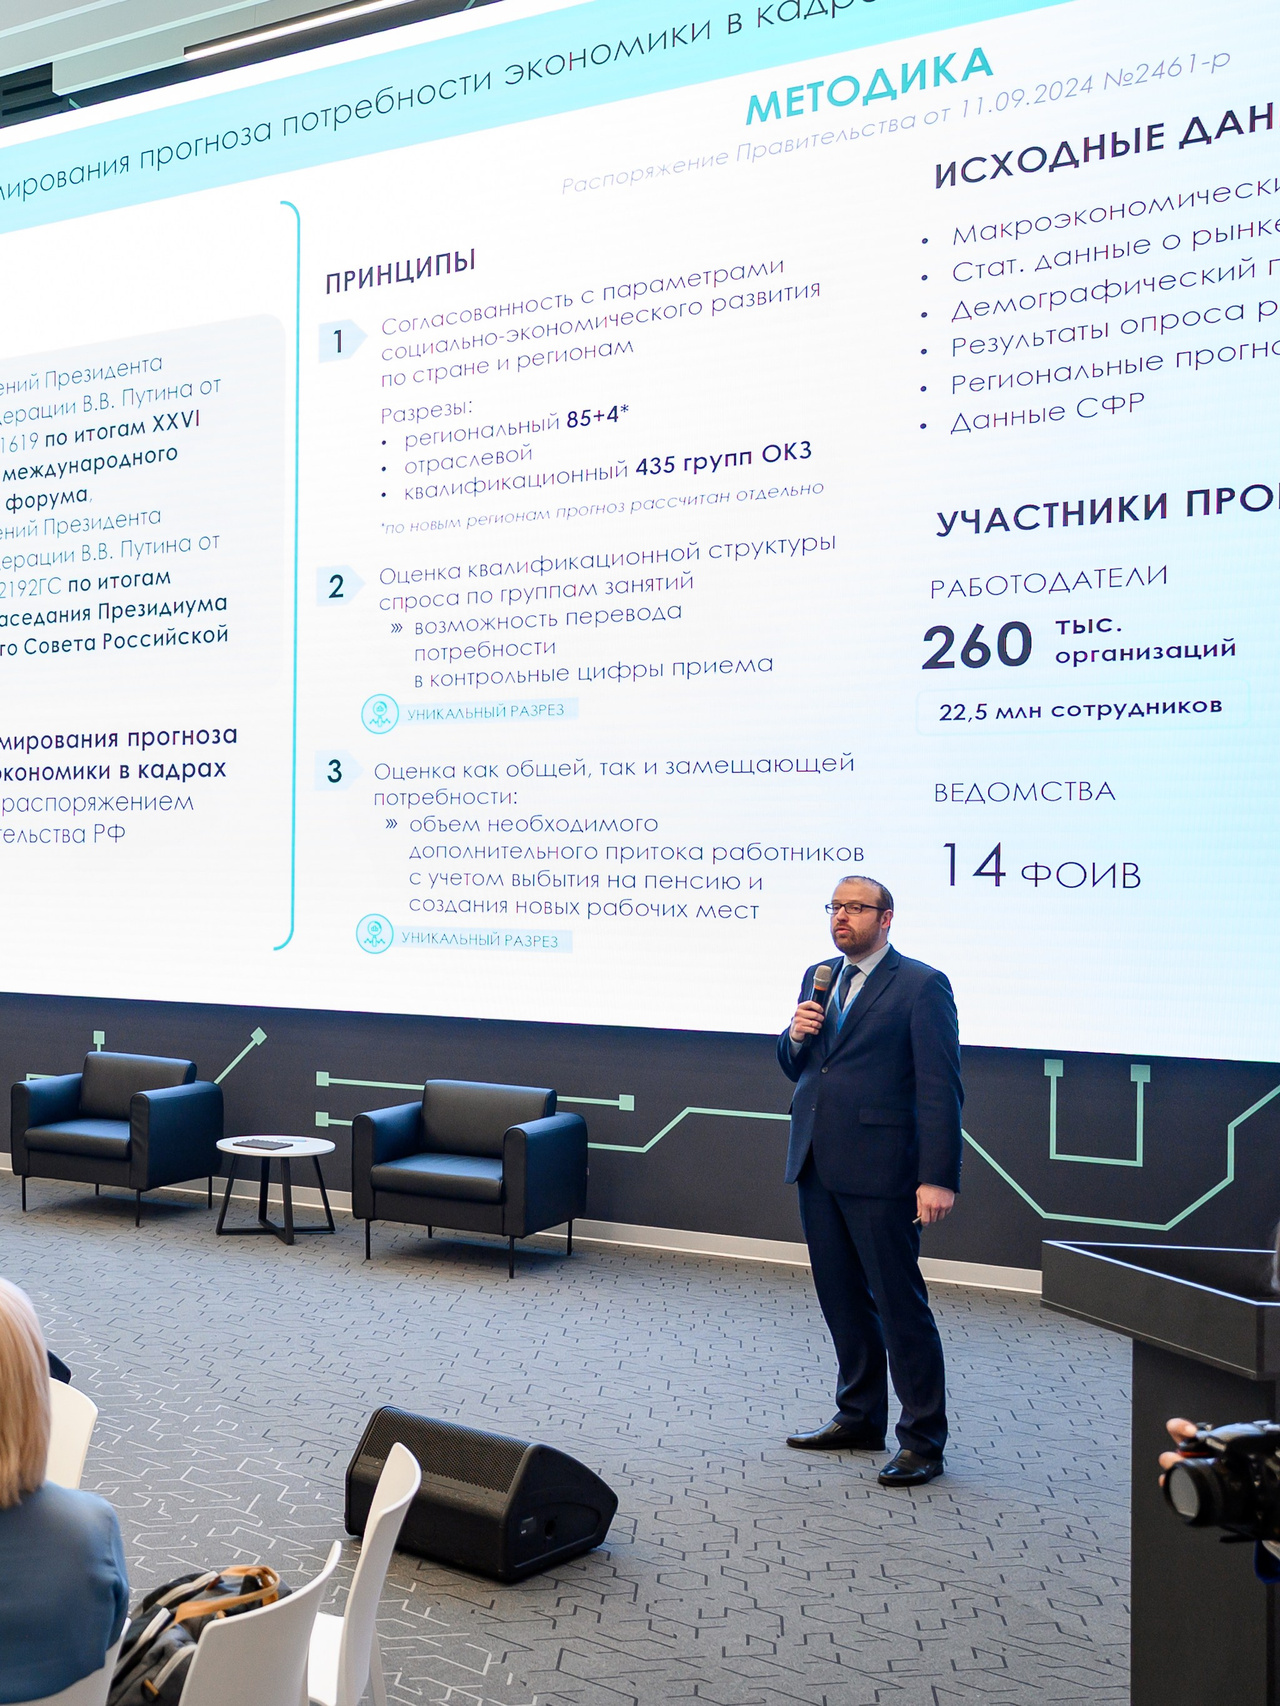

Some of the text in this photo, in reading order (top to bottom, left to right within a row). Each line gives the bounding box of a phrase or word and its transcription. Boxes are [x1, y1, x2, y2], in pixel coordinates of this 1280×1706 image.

[141, 122, 270, 171] прогноза
[284, 72, 490, 136] потребности
[505, 20, 710, 85] экономики
[728, 13, 742, 35] в
[745, 47, 994, 125] МЕТОДИКА
[562, 52, 1230, 195] Распоряжение Правительства от 11.09.2024 №2461-р
[936, 102, 1273, 189] ИСХОДНЫЕ ДАН
[327, 248, 474, 294] ПРИНЦИПЫ
[953, 259, 1024, 282] Стат.
[1035, 239, 1151, 272] данные
[1163, 234, 1180, 250] о
[382, 260, 783, 335] Согласованность параметрами
[951, 257, 1255, 323] Демографический
[382, 283, 820, 361] социально-экономического развития
[953, 322, 1108, 357] Результаты
[1121, 304, 1244, 335] опроса
[333, 329, 341, 353] 1
[45, 357, 162, 391] Президента
[382, 340, 633, 387] по стране регионам
[953, 355, 1163, 394] Региональные
[83, 392, 114, 412] В.В.
[123, 383, 192, 409] Путина
[200, 379, 221, 395] от
[382, 401, 472, 424] Разрезы:
[951, 392, 1144, 435] Данные СФР
[45, 432, 67, 447] по
[75, 421, 145, 443] итогам
[406, 412, 559, 452] региональный
[3, 447, 178, 482] международного
[405, 443, 532, 476] отраслевой
[405, 460, 627, 500] квалификационный
[636, 456, 675, 476] 435
[684, 451, 752, 475] групп
[410, 483, 824, 532] новым регионам прогноз рассчитан отдельно
[936, 483, 1280, 537] УЧАСТНИКИ ПРО
[44, 510, 161, 539] Президента
[82, 543, 113, 561] В.В.
[121, 538, 191, 561] Путина
[198, 535, 220, 550] от
[380, 535, 835, 585] Оценка квалификационной структуры
[68, 578, 91, 592] по
[98, 571, 172, 590] итогам
[328, 574, 344, 598] 2
[379, 571, 693, 613] спроса по группам занятий
[932, 565, 1166, 599] РАБОТОДАТЕЛИ
[99, 597, 227, 623] Президиума
[415, 605, 681, 635] возможность перевода
[24, 638, 95, 655] Совета
[103, 624, 228, 650] Российской
[1055, 618, 1121, 635] тыс.
[415, 641, 555, 664] потребности
[922, 621, 1032, 670] 260
[1056, 638, 1235, 667] организаций
[431, 658, 773, 689] контрольные цифры приема
[407, 702, 565, 721] УНИКАЛЬНЫЙ РАЗРЕЗ
[940, 700, 1222, 722] 22,5 млн сотрудников
[128, 728, 237, 751] прогноза
[120, 765, 129, 779] в
[139, 762, 226, 783] кадрах
[327, 759, 342, 783] 3
[374, 752, 854, 781] Оценка как общей, так и замещающей
[2, 795, 194, 817] распоряжением
[374, 788, 517, 809] потребности:
[935, 781, 1116, 804] ВЕДОМСТВА
[94, 824, 125, 843] РФ
[410, 814, 658, 833] объем необходимого
[409, 842, 864, 865] дополнительного притока работников
[943, 842, 1141, 888] 14 ФОИВ
[428, 870, 762, 890] учетом выбытия на пенсию и
[409, 898, 759, 919] создания новых рабочих мест
[401, 929, 559, 949] УНИКАЛЬНЫЙ РАЗРЕЗ
